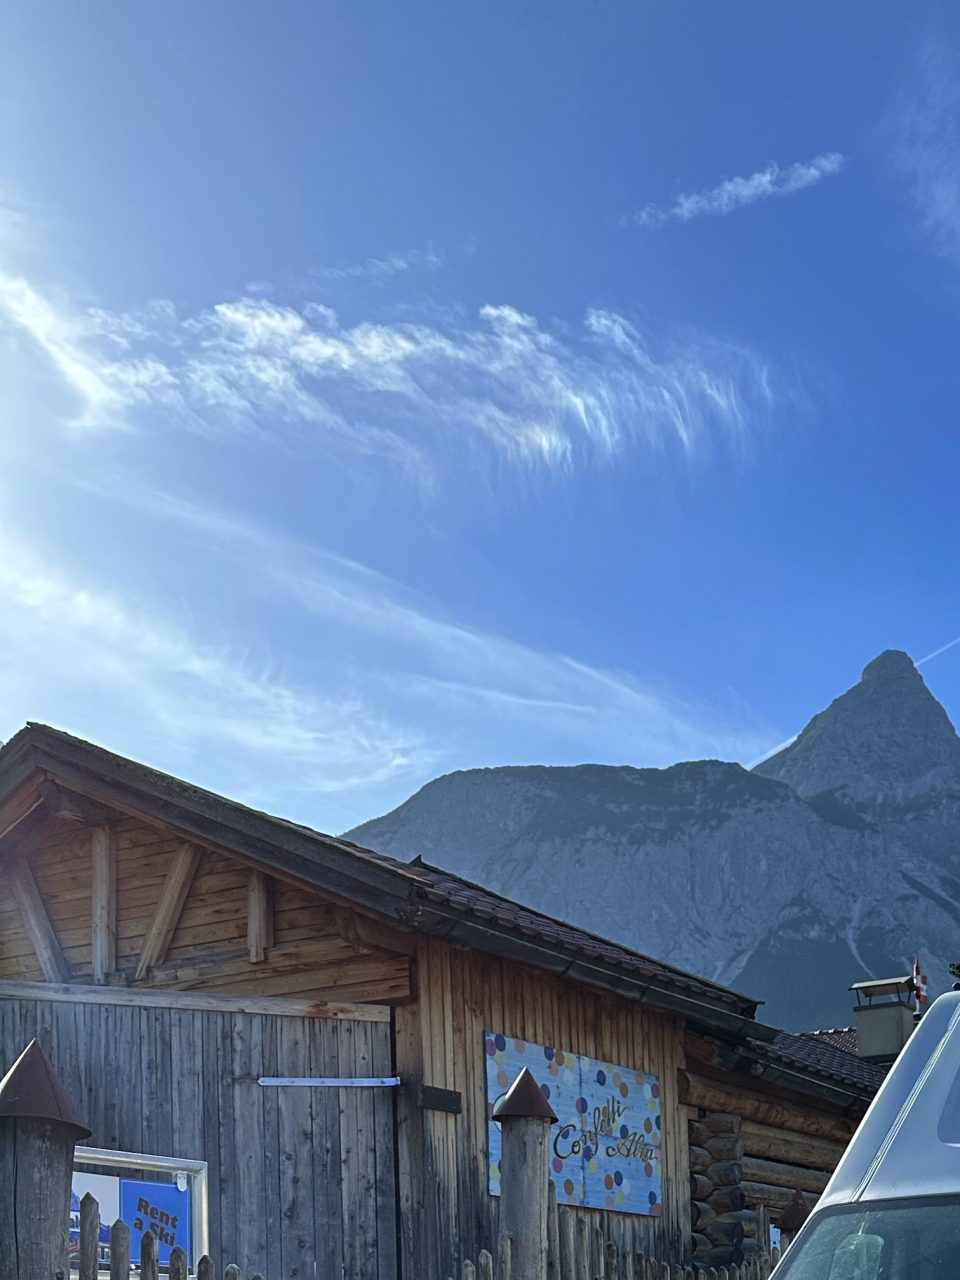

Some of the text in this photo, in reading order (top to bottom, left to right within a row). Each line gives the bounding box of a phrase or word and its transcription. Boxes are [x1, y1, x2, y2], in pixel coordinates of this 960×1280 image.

[606, 1132, 657, 1160] Alm
[137, 1197, 178, 1229] Rent
[134, 1216, 176, 1247] a Ski
